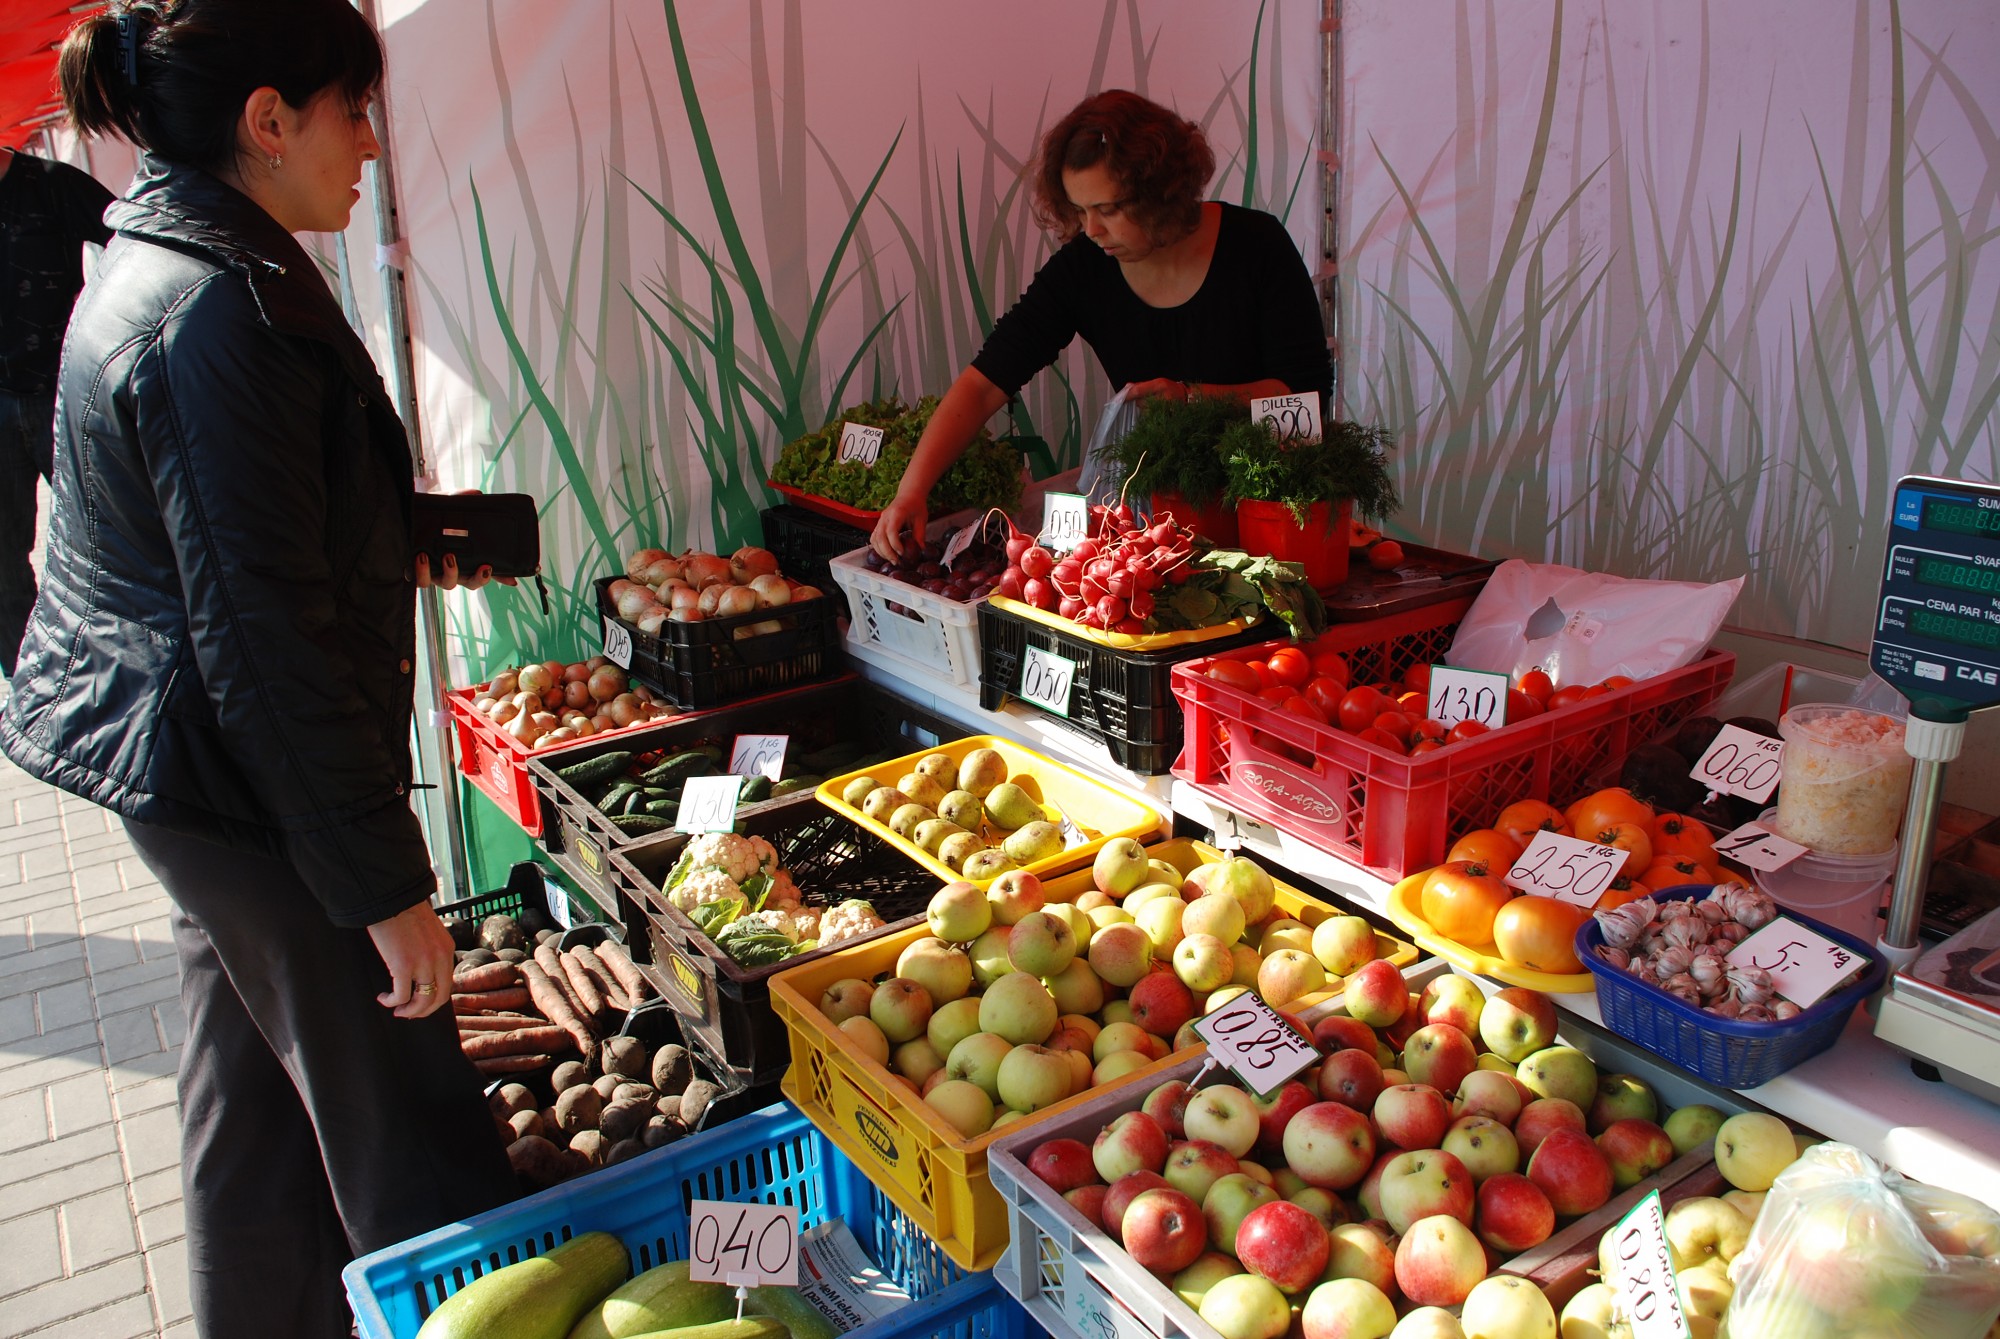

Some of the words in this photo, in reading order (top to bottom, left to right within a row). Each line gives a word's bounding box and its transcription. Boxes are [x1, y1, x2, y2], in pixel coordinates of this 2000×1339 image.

[1262, 397, 1303, 412] DILLES
[1899, 513, 1919, 523] EURO
[1895, 568, 1910, 576] TARA
[1926, 598, 1956, 613] CENA
[1958, 605, 1981, 618] PAR
[1956, 665, 1998, 686] CAS
[1250, 995, 1311, 1050] DELIKATESE
[694, 1208, 792, 1276] 0,40
